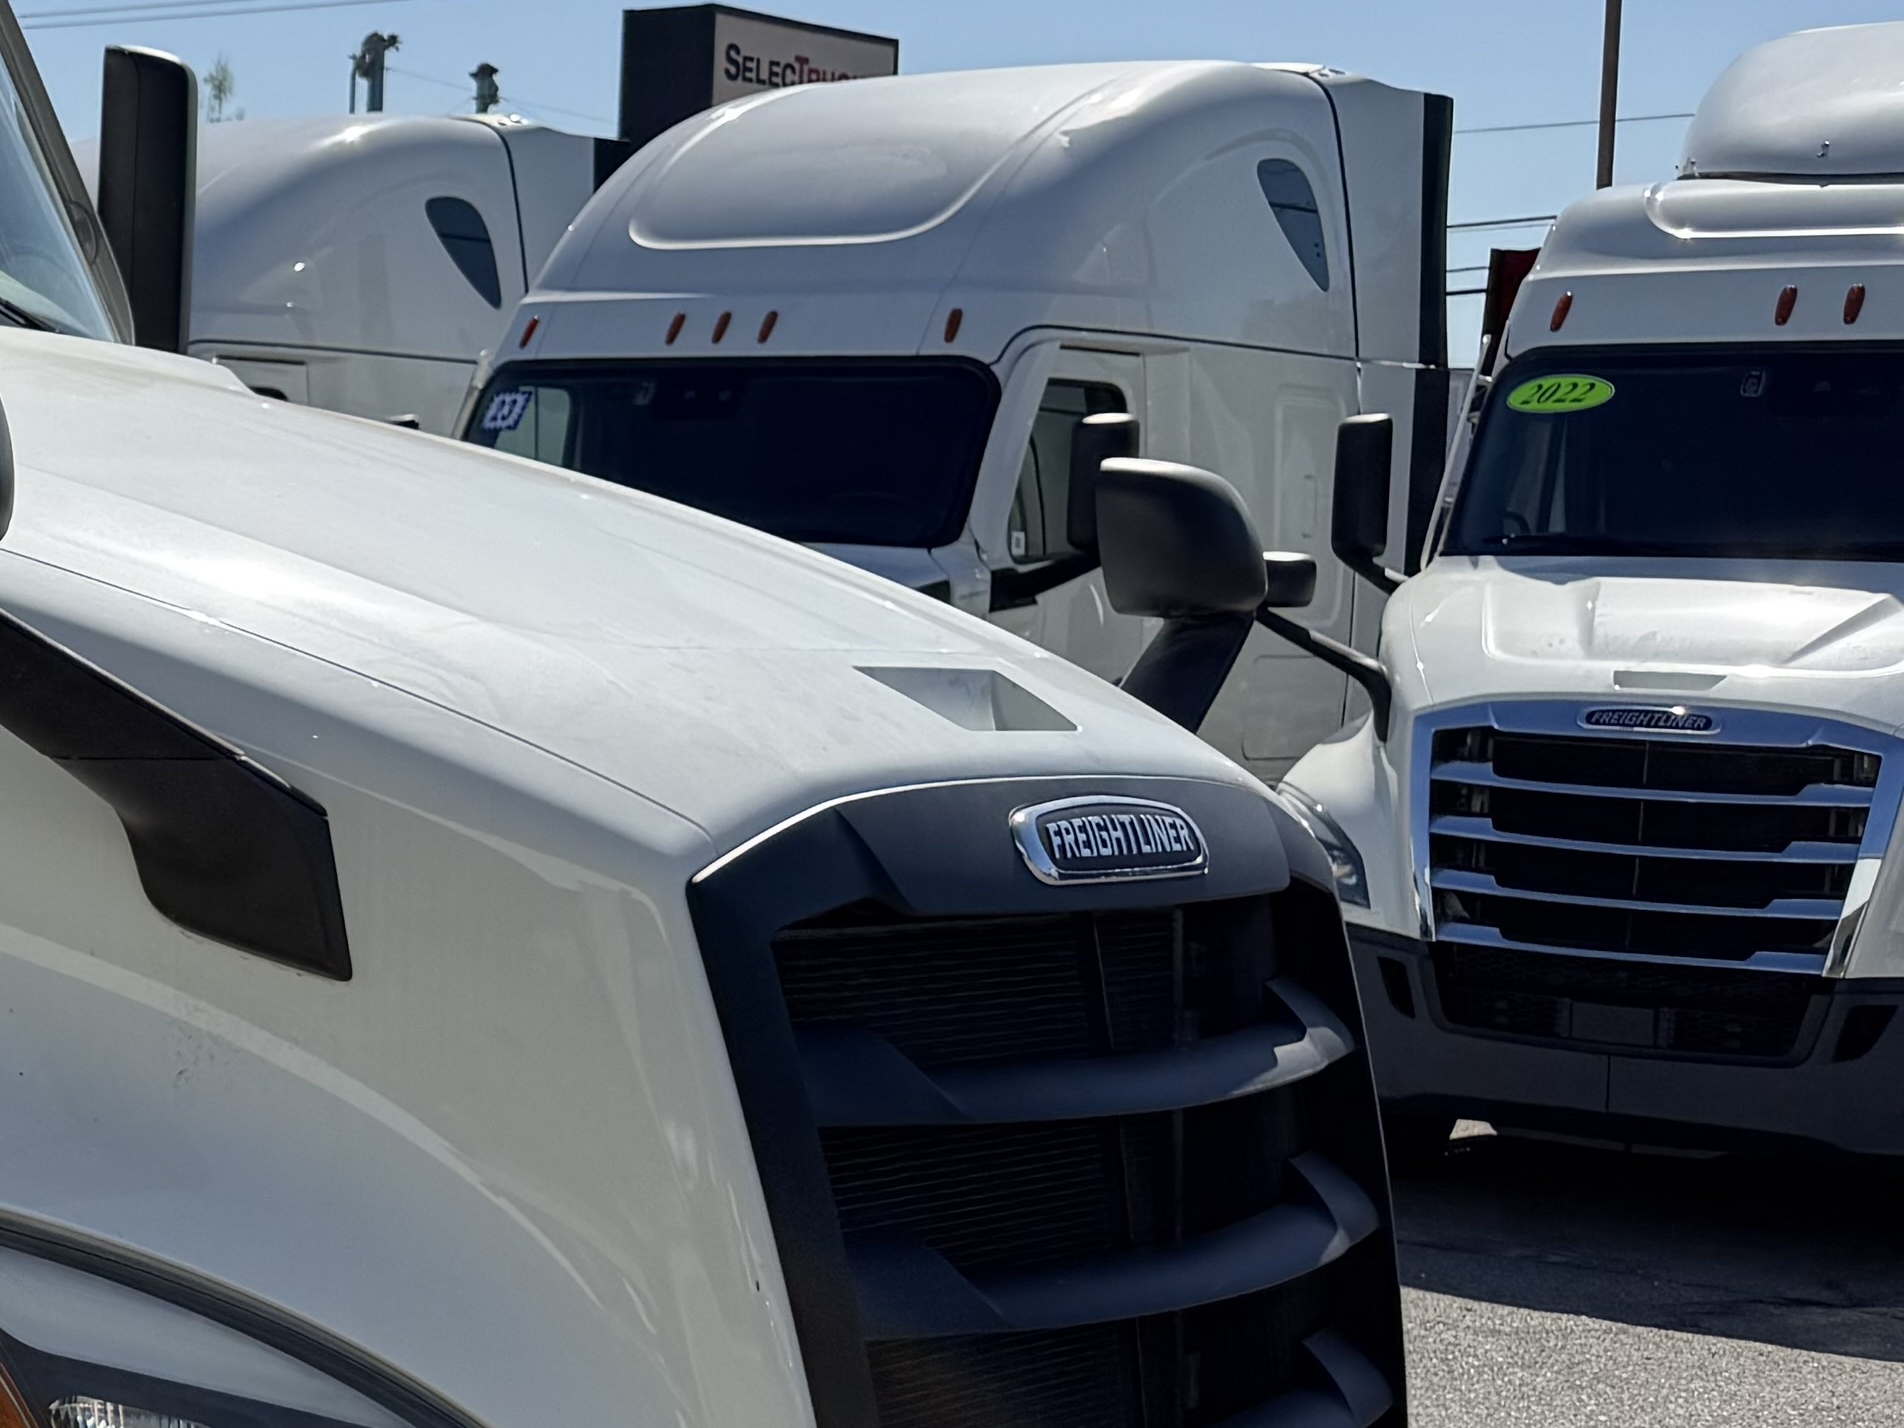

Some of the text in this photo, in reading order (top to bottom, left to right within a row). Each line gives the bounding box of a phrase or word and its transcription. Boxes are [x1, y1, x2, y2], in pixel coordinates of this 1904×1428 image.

[1519, 381, 1596, 405] 2022
[1592, 711, 1706, 729] FREIGHTLINER
[1045, 814, 1194, 859] FREIGHTLINER
